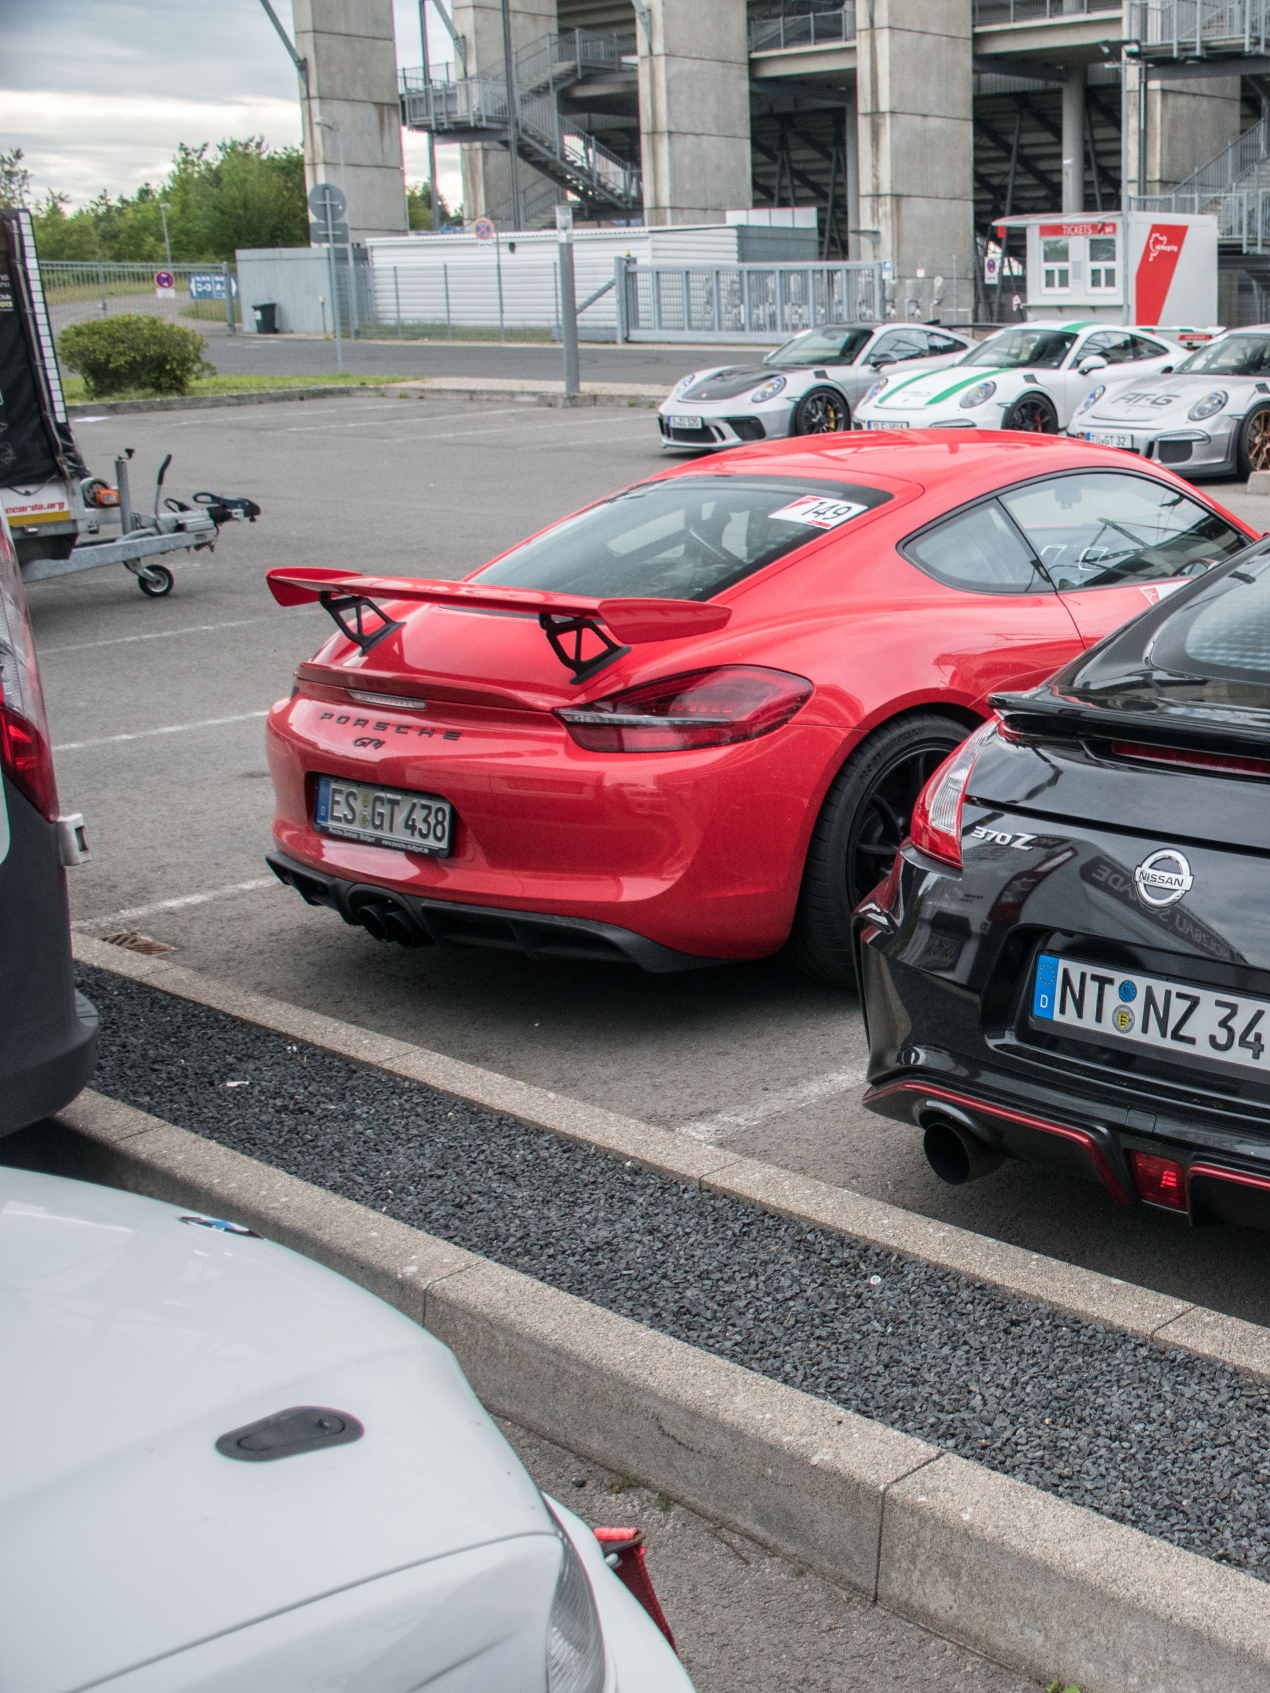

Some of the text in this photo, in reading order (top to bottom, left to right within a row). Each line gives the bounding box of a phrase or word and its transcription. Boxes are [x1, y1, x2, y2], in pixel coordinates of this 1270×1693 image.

[1062, 224, 1093, 236] TICKETS
[1116, 437, 1126, 446] 32
[801, 501, 853, 520] 149
[319, 711, 463, 741] PORSCHE
[352, 736, 386, 749] GT4
[330, 785, 358, 824] ES
[371, 793, 401, 833] GT
[404, 801, 447, 843] 438
[970, 826, 1037, 851] 370Z
[1138, 871, 1184, 888] NISSAN
[1039, 966, 1266, 1060] D NT NZ 34
